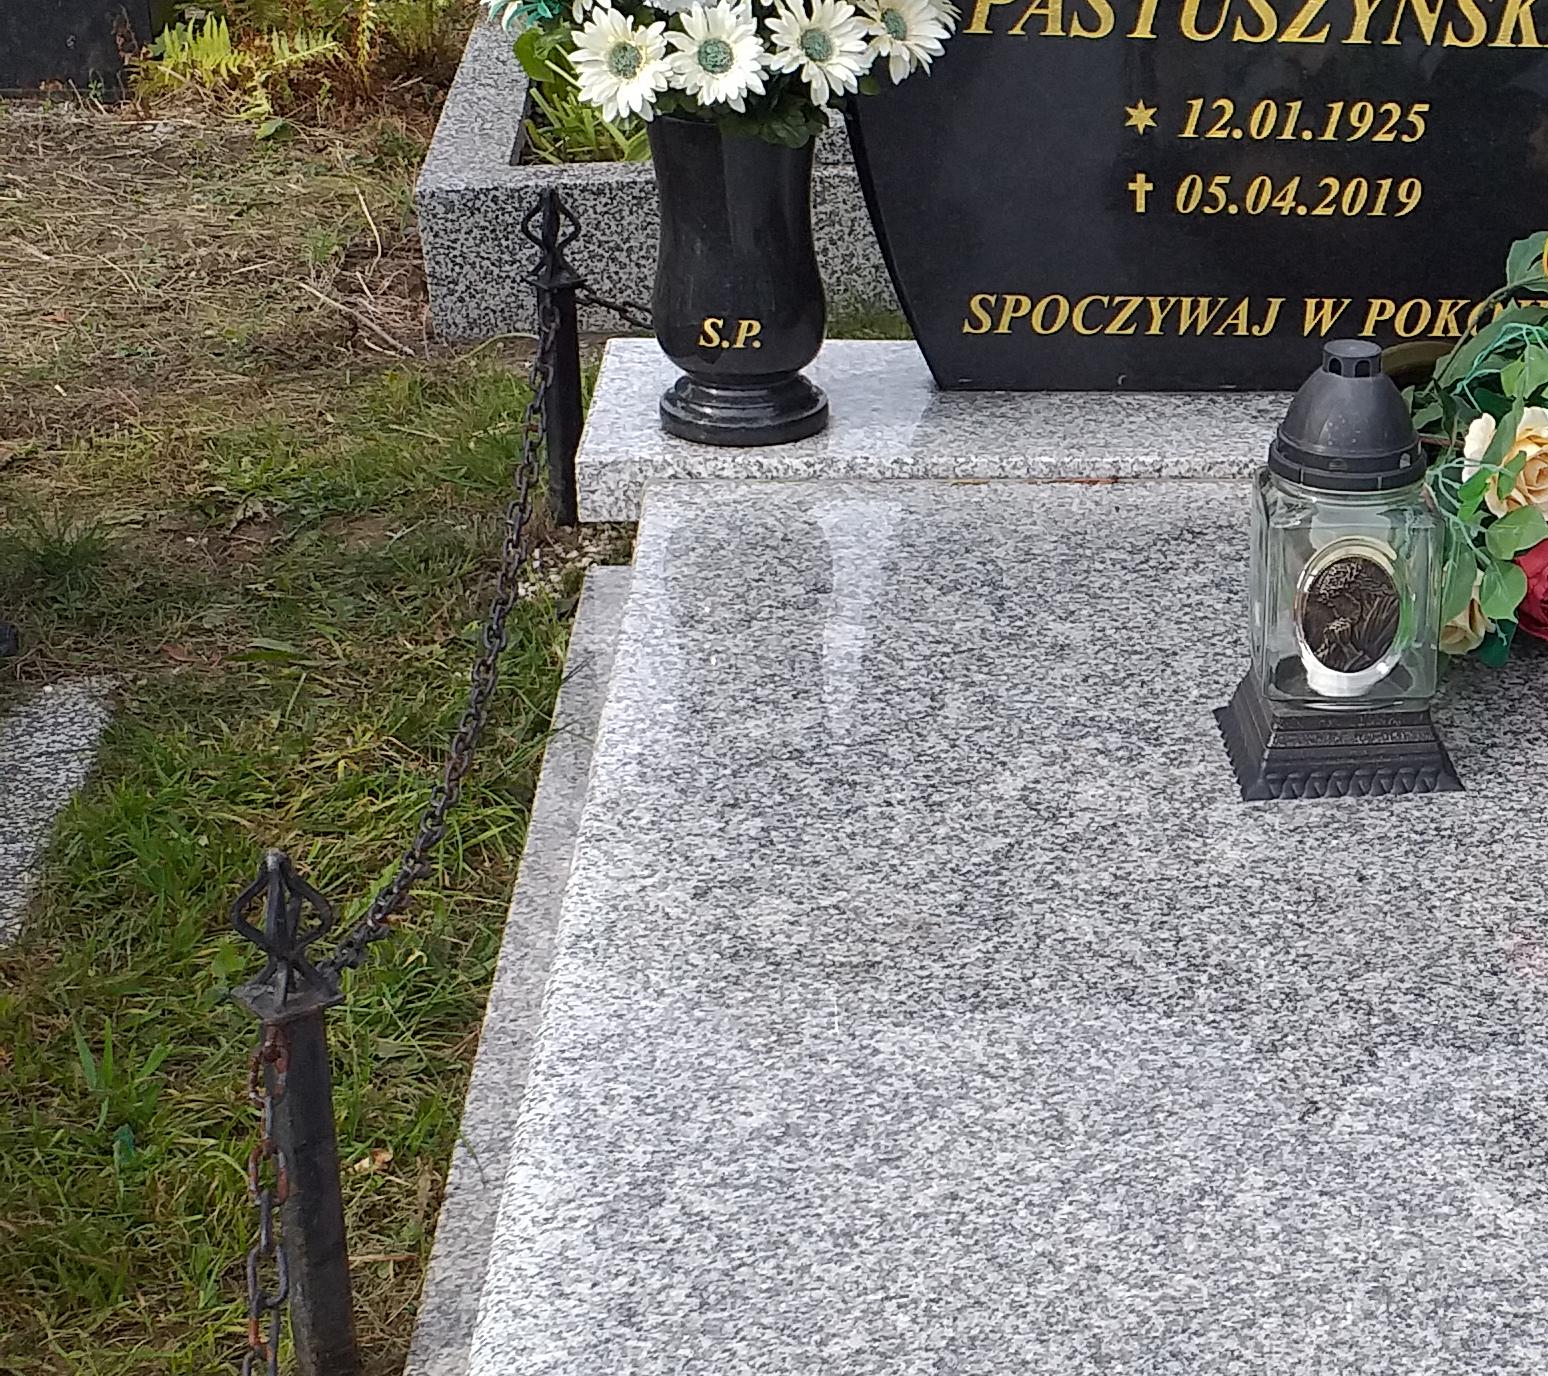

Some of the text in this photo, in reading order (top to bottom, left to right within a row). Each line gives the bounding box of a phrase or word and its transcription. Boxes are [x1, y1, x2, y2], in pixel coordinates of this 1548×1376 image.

[1176, 97, 1431, 144] 12.01.1925
[1174, 175, 1423, 218] 05.04.2019
[698, 317, 763, 349] S.P.
[961, 292, 1287, 337] SPOCZYWAJ
[1303, 296, 1353, 337] W
